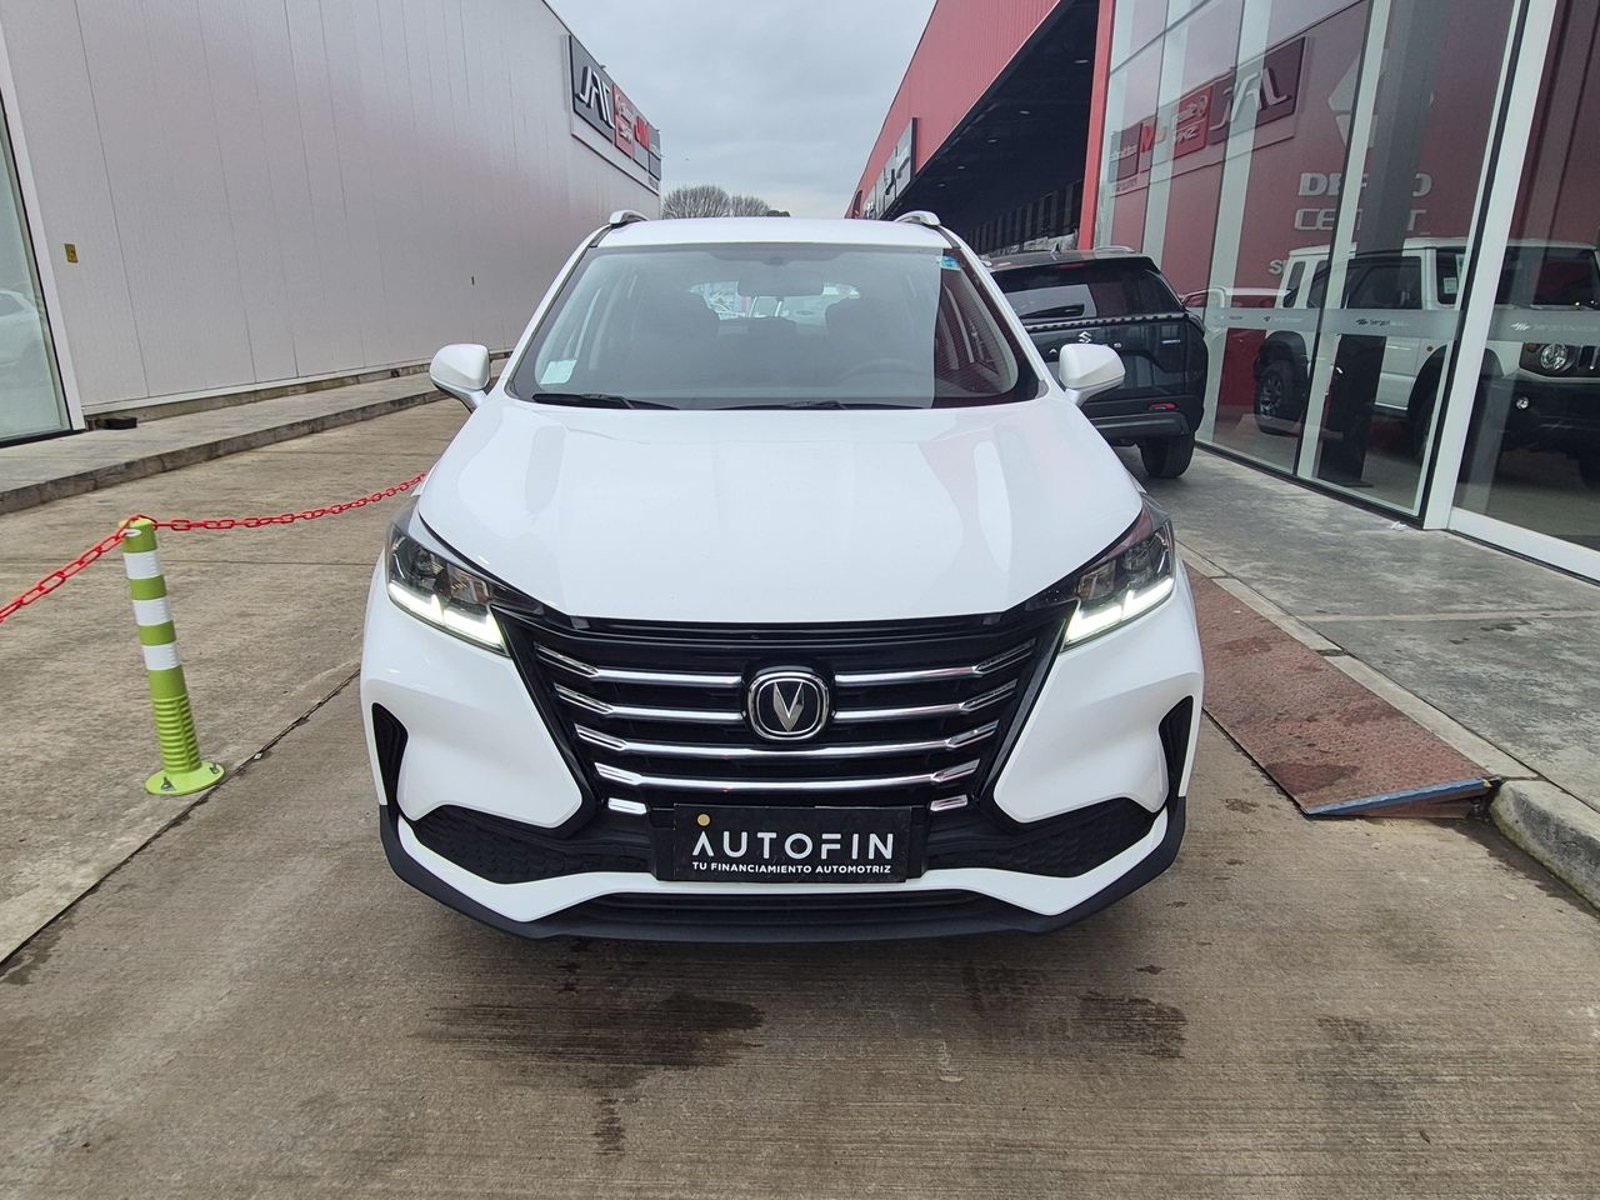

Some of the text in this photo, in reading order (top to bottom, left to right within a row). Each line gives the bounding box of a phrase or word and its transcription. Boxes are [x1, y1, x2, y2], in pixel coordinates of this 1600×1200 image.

[692, 830, 894, 860] AUTOFIN
[692, 861, 892, 875] TU FINANCIAMIENTO AUTOMOTRIZ
